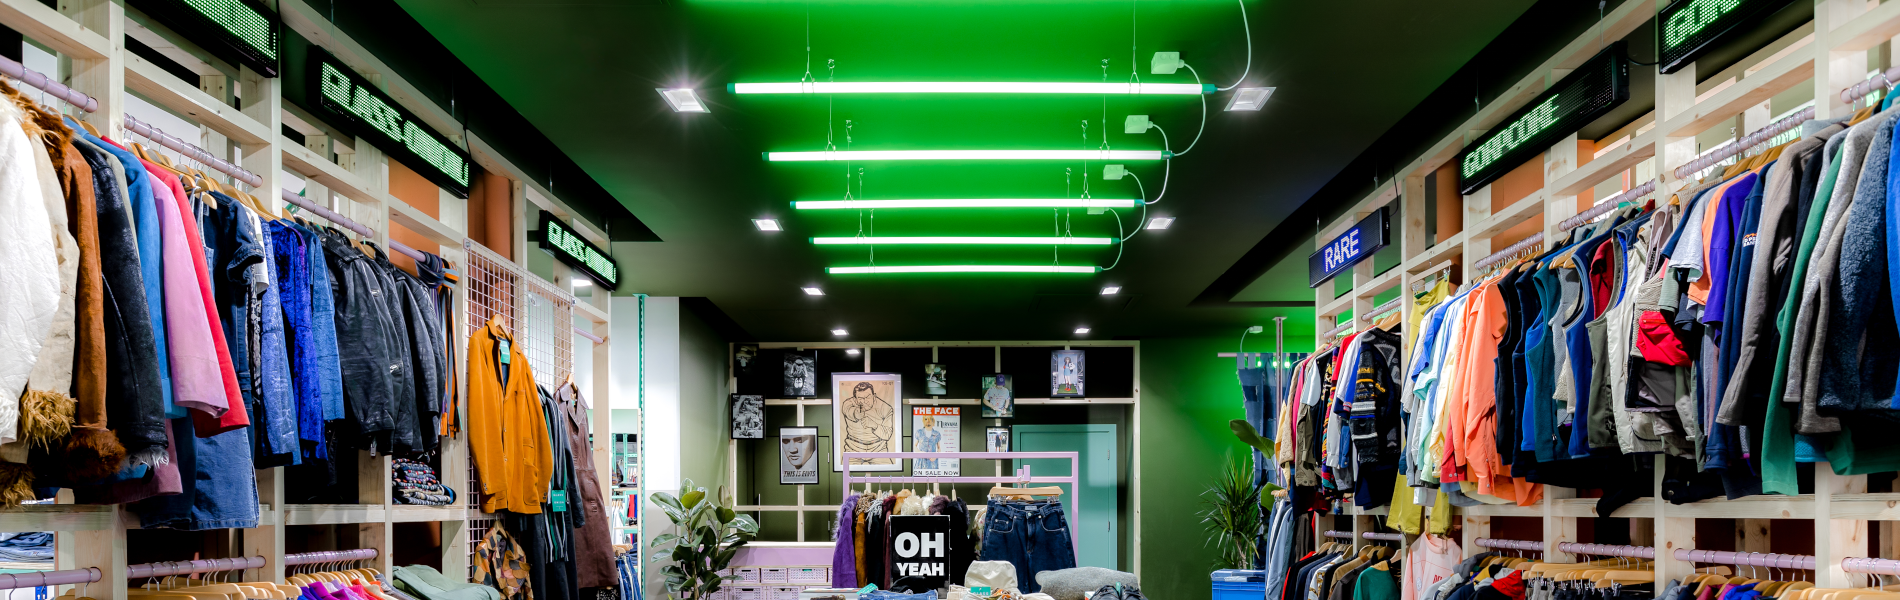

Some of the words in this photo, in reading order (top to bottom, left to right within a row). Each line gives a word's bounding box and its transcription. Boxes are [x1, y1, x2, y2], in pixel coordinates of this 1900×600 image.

[1324, 228, 1359, 272] RARE
[913, 407, 932, 415] THE
[934, 407, 959, 415] FACE
[894, 531, 945, 558] OH
[896, 562, 944, 577] YEAH
